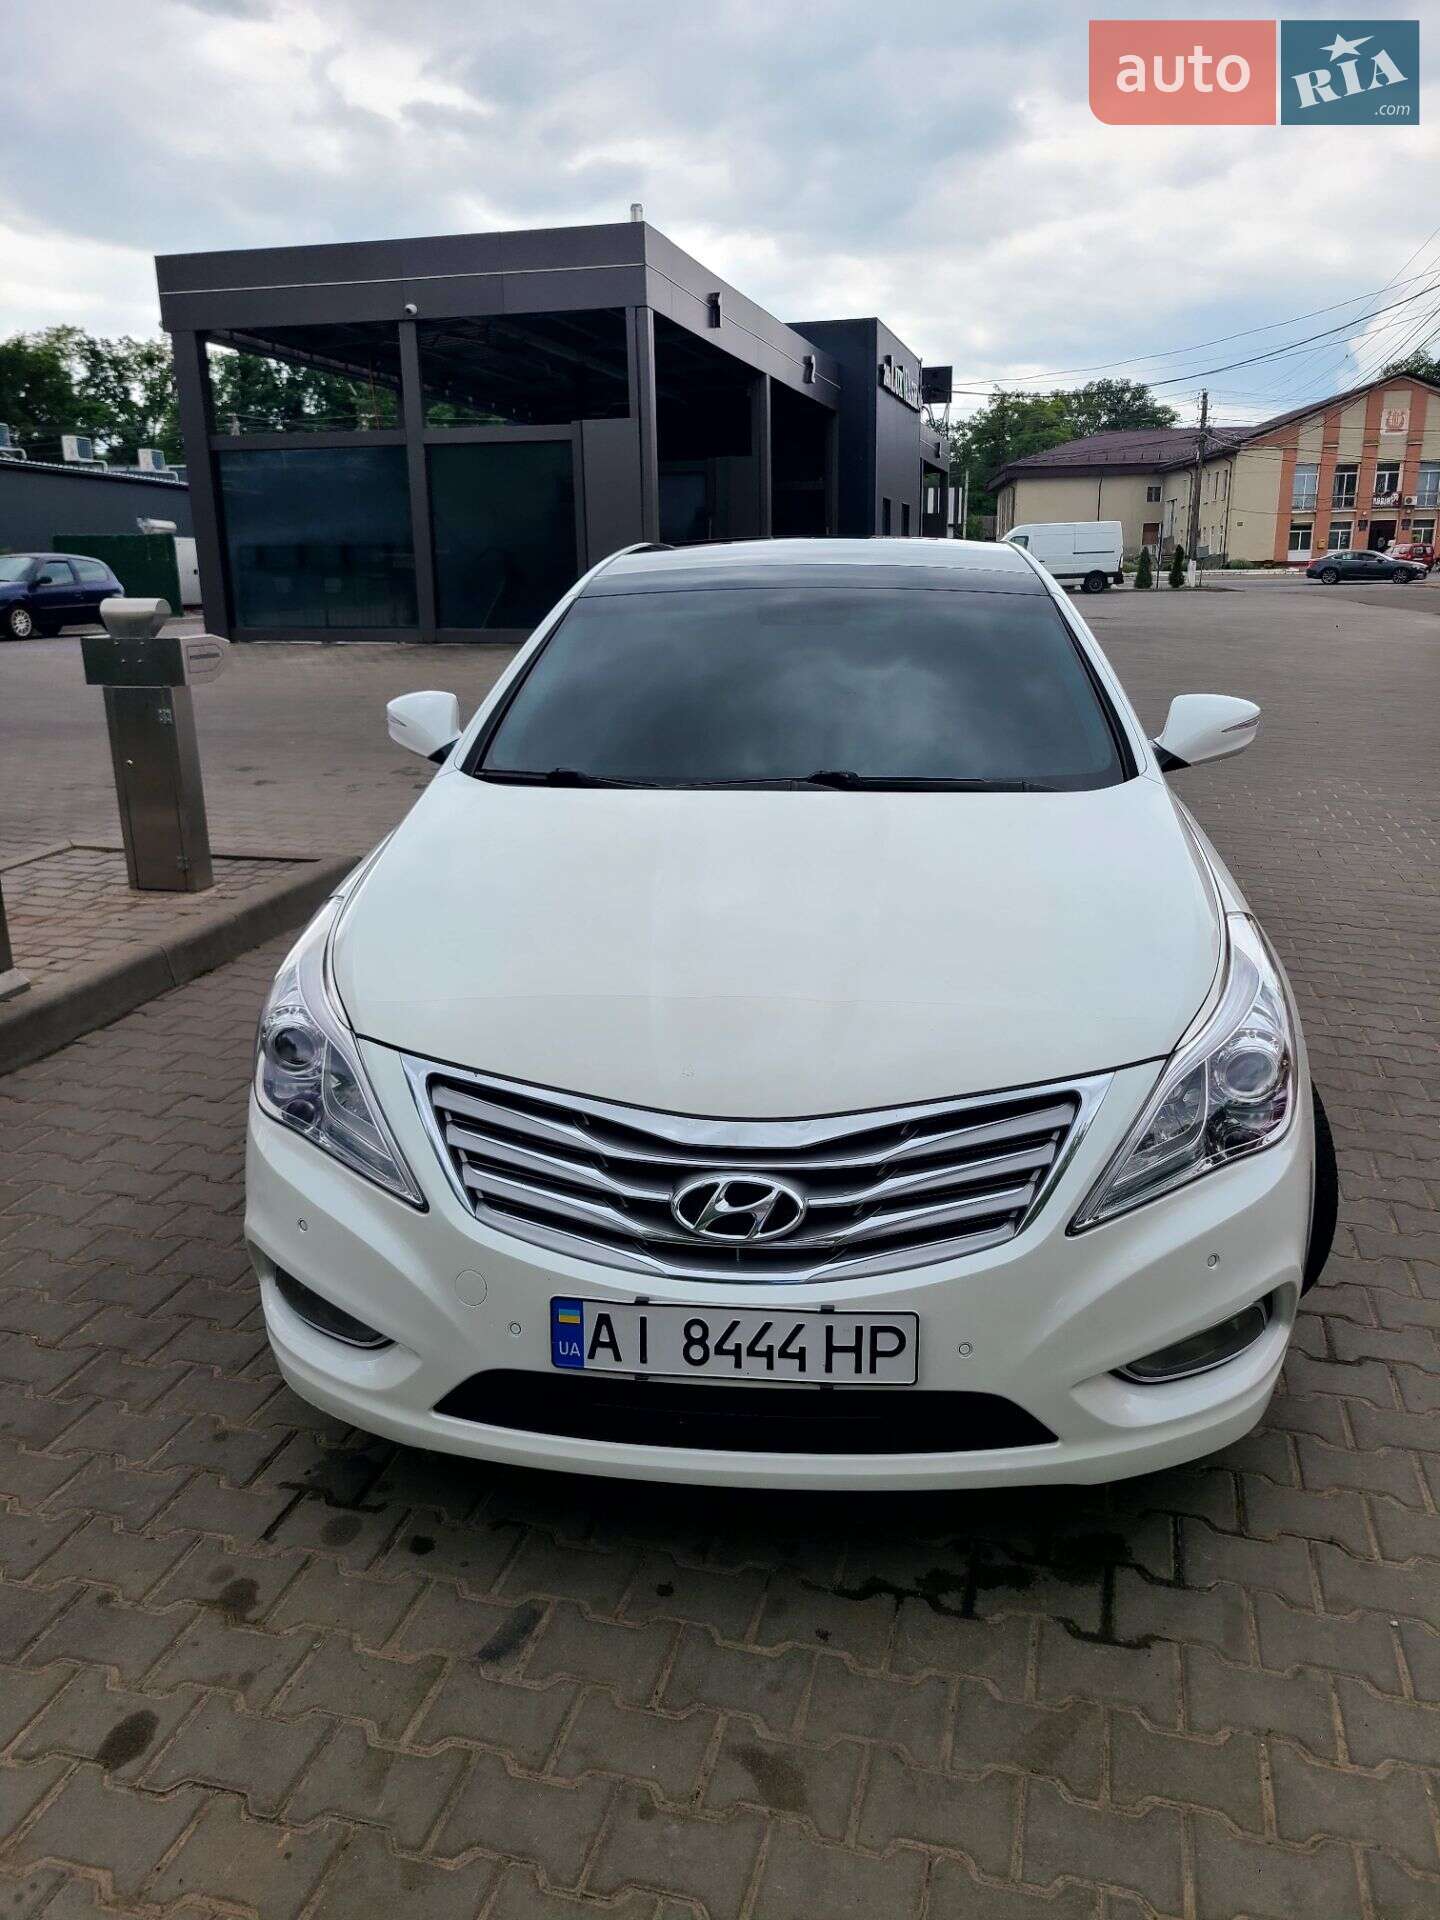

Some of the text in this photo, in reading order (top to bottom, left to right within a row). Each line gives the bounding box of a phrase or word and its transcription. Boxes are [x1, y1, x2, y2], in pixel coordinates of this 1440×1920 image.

[559, 1340, 581, 1357] UA
[587, 1313, 907, 1374] AI 8444 HP
